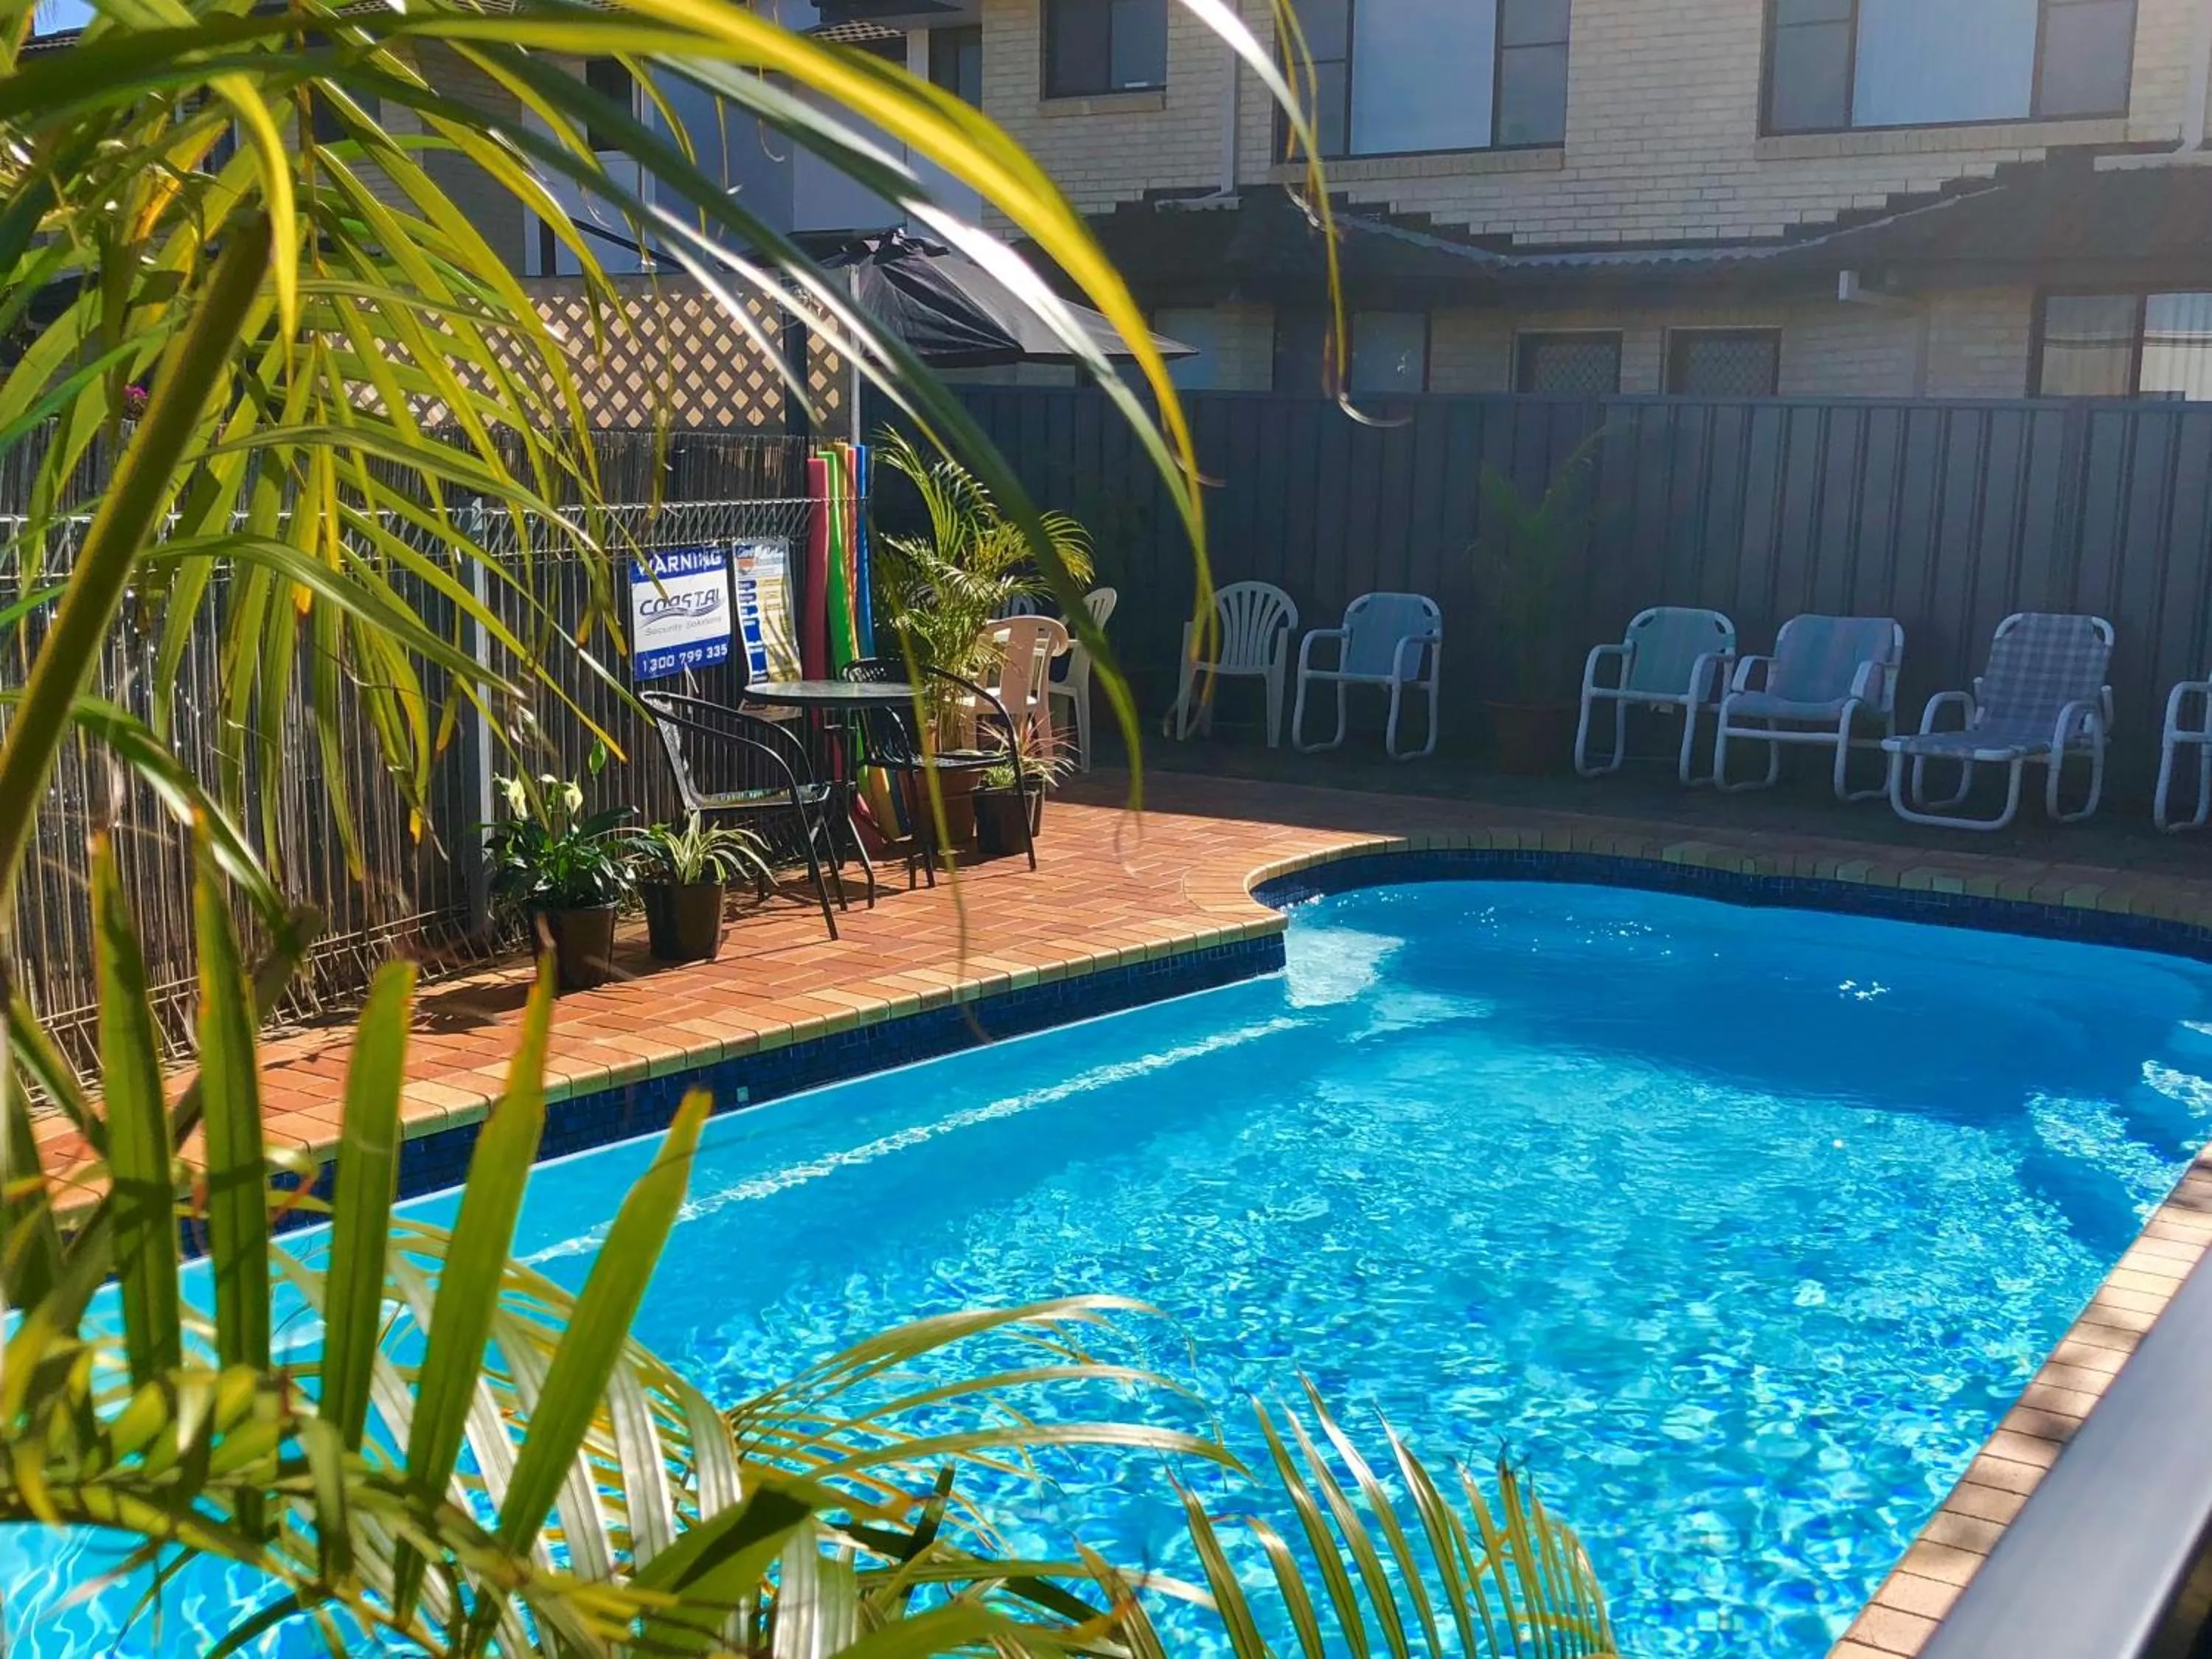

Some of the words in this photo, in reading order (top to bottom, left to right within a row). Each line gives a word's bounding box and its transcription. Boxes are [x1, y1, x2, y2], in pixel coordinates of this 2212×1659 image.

[643, 655, 675, 672] 1300
[679, 649, 702, 664] 799
[706, 644, 728, 658] 335
